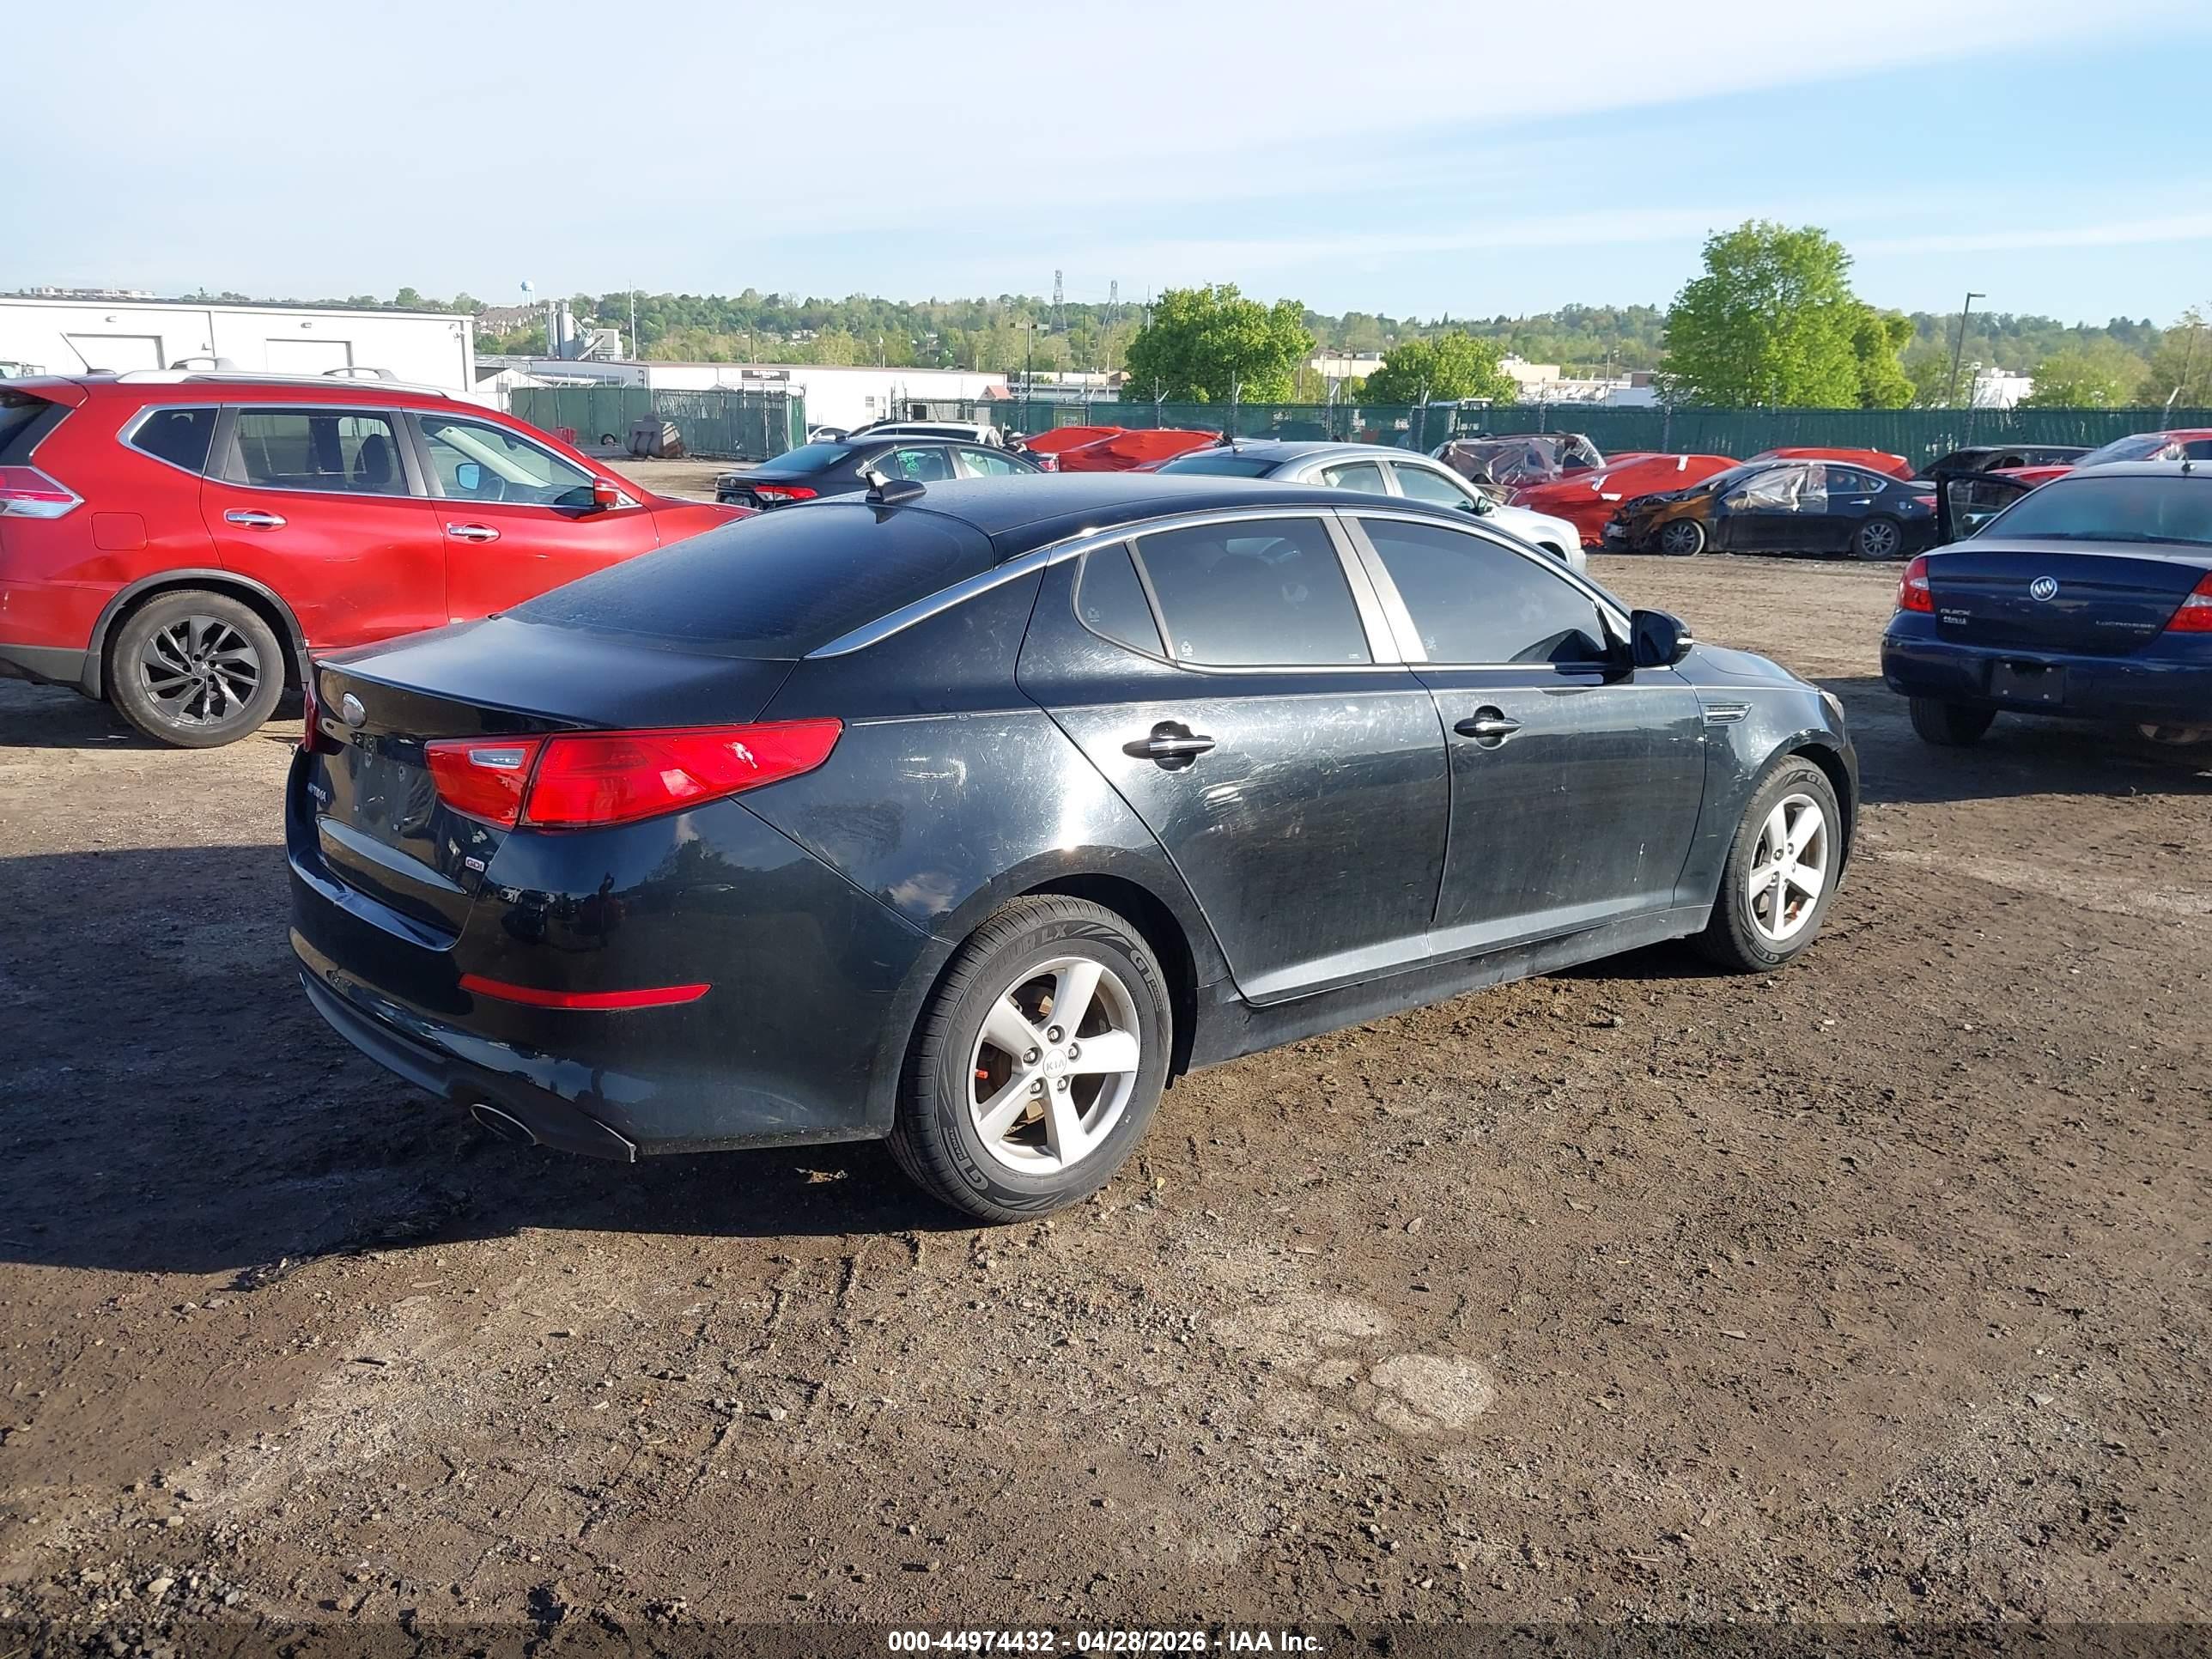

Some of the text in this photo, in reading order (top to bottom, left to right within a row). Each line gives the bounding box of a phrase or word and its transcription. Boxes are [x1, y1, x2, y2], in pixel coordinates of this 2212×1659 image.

[466, 859, 483, 870] GDI
[1041, 923, 1067, 943] LX
[1046, 1059, 1065, 1072] KIA
